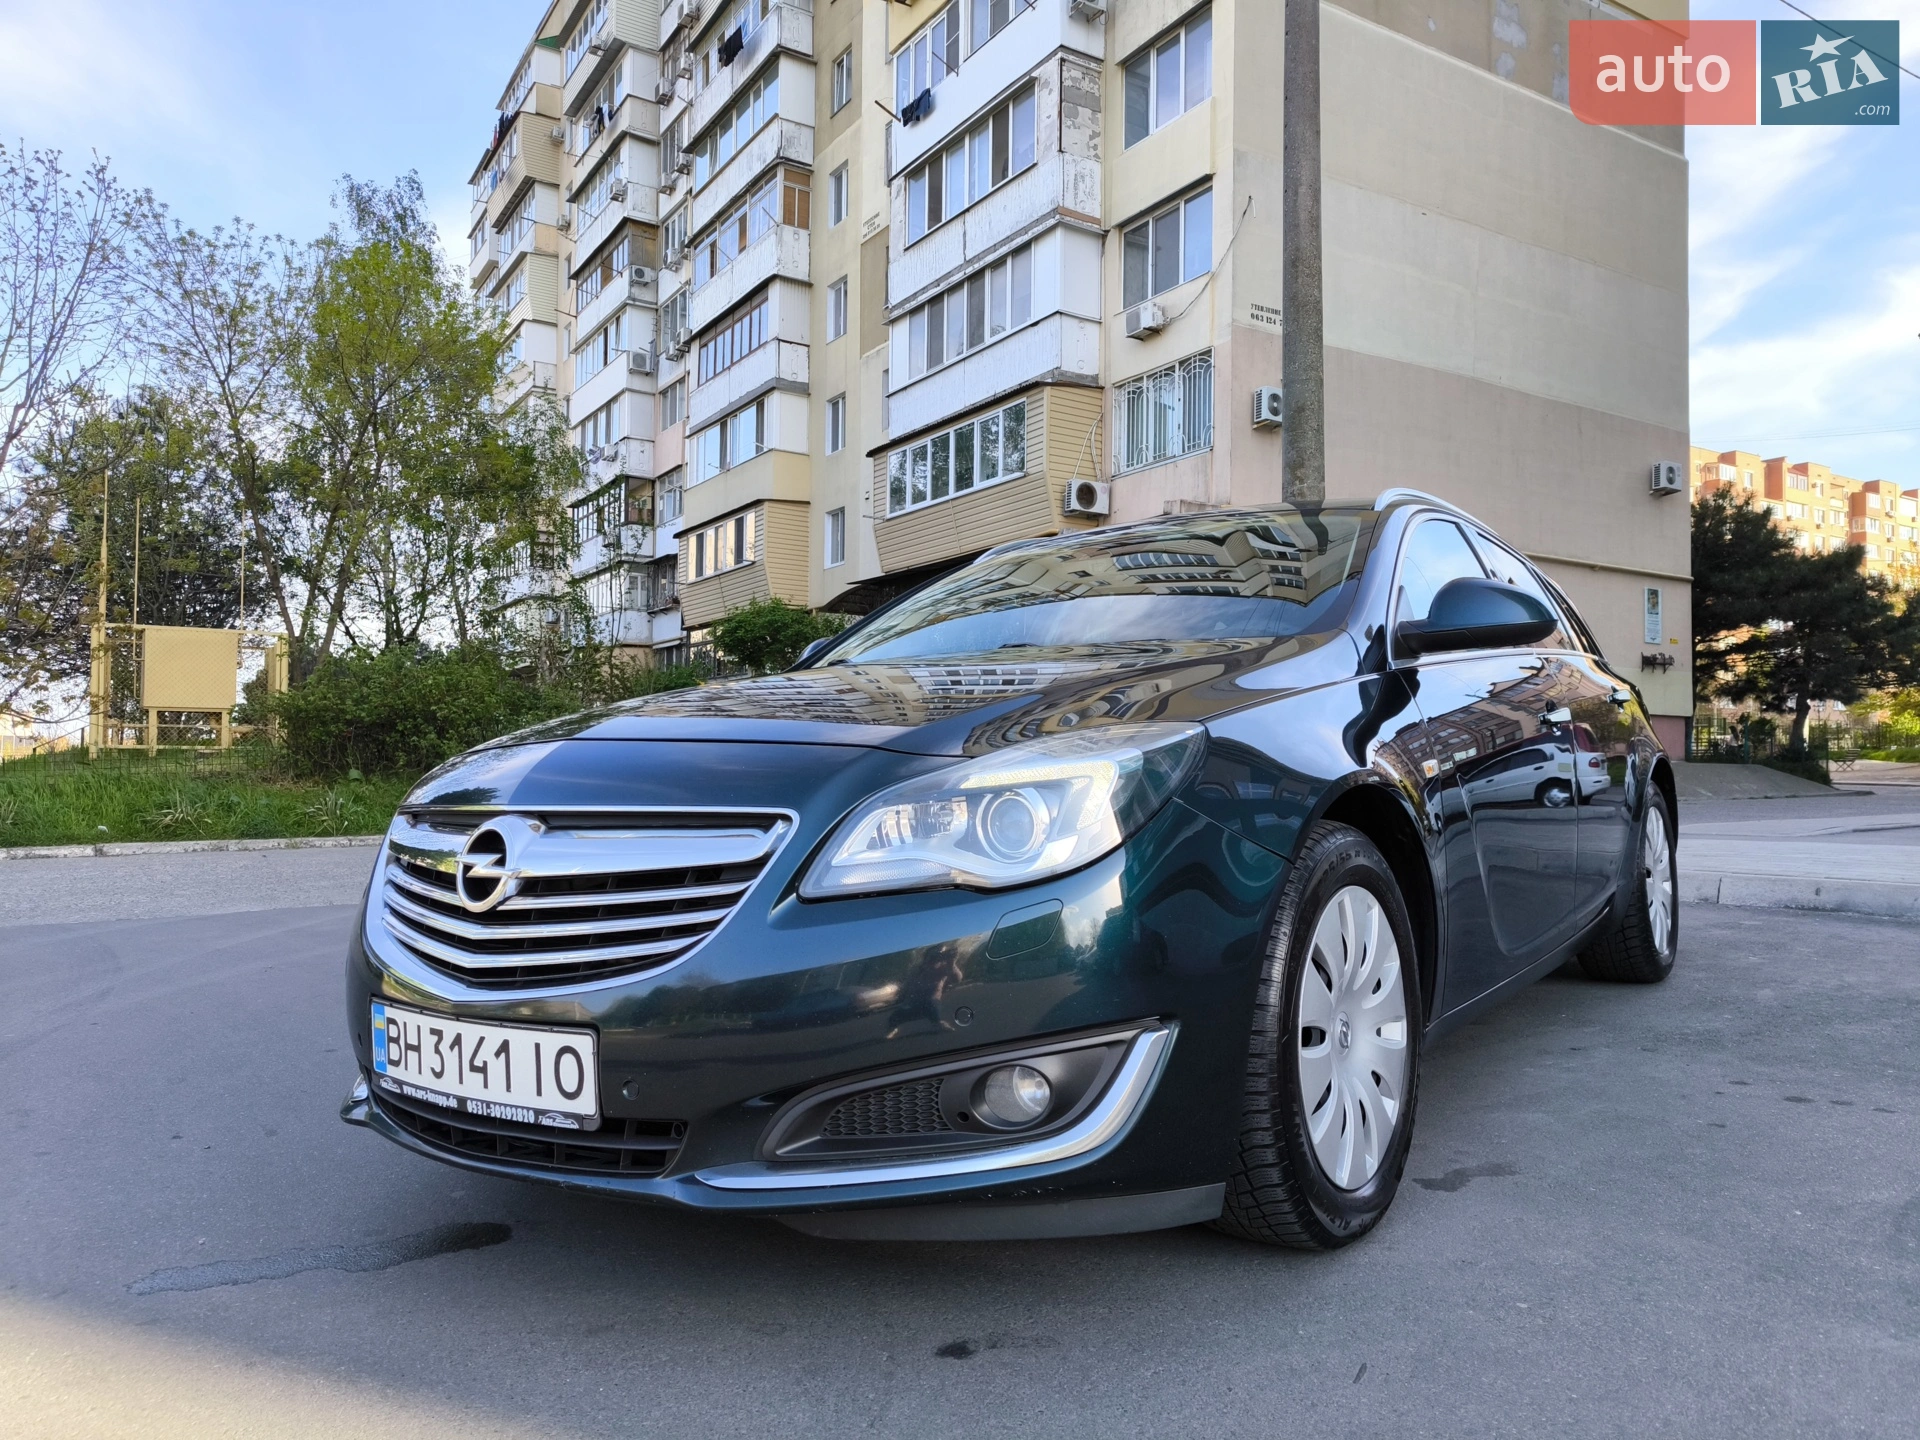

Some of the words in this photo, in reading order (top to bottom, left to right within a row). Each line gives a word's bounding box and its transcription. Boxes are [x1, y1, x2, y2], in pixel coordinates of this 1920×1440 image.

[375, 1046, 386, 1064] UA
[386, 1016, 423, 1075] BH
[429, 1027, 512, 1093] 3141
[402, 1083, 459, 1109] www.ars-knapp.de
